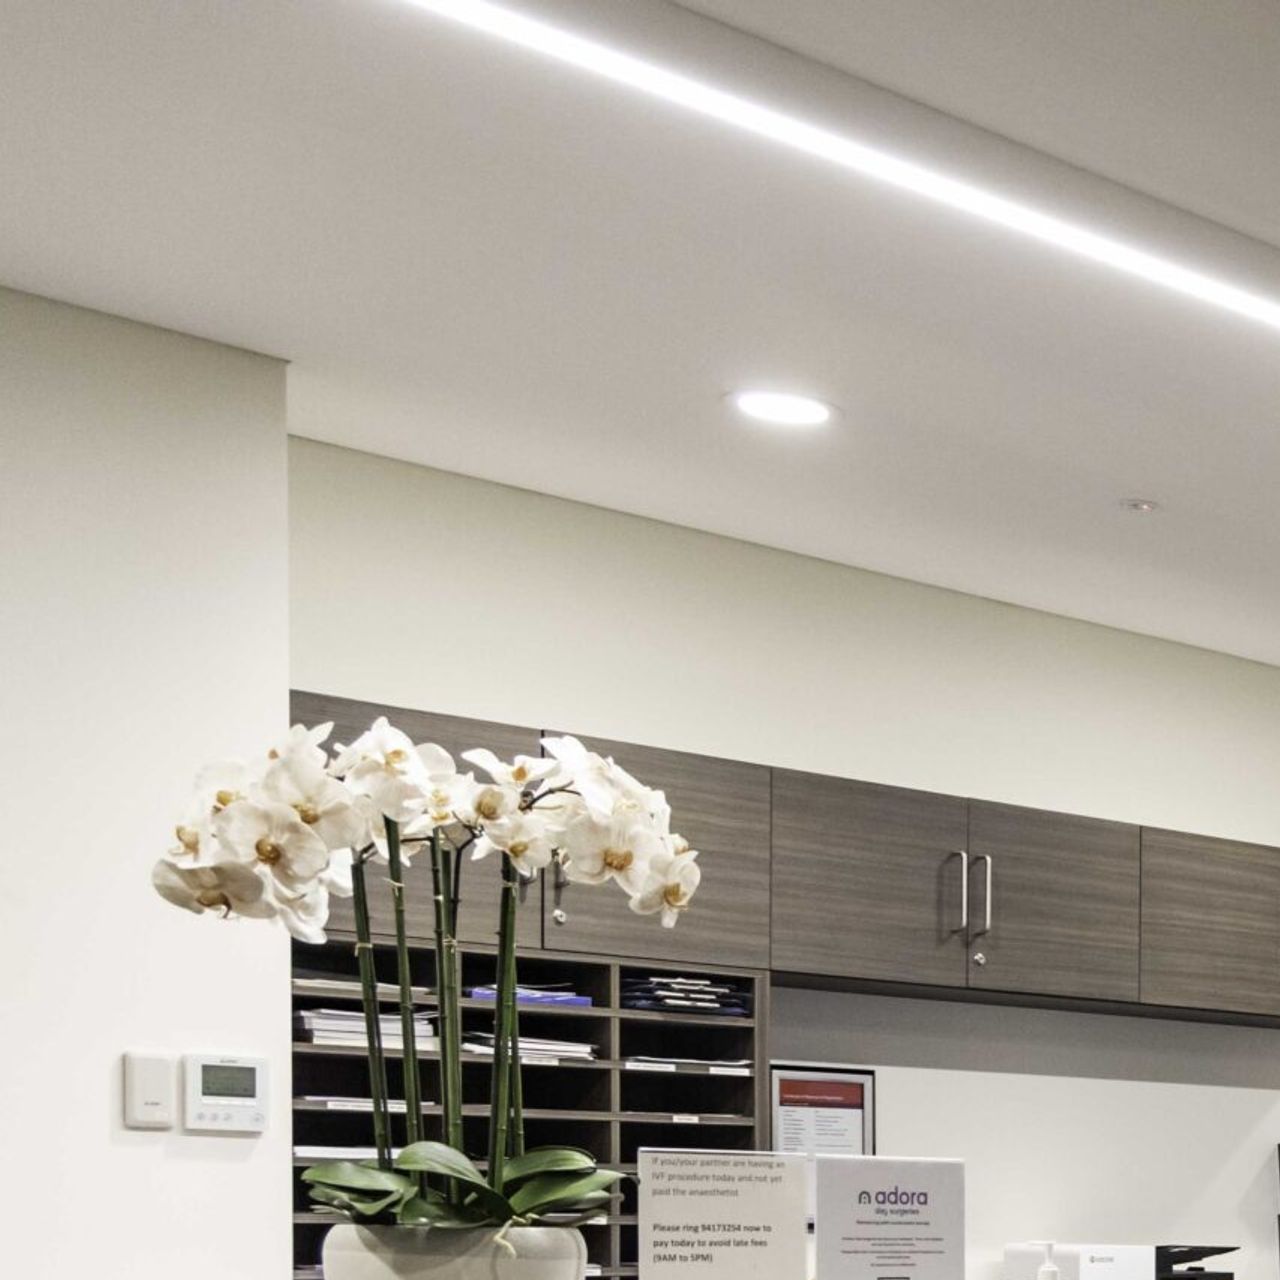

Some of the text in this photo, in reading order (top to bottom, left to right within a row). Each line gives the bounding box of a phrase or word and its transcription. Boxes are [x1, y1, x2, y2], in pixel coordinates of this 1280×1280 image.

[660, 1158, 697, 1167] you/your
[700, 1160, 731, 1168] partner
[747, 1160, 773, 1169] having
[667, 1173, 709, 1182] procedure
[712, 1173, 735, 1182] today
[652, 1188, 670, 1197] paid
[875, 1185, 928, 1205] adora
[653, 1223, 681, 1232] Please
[682, 1223, 699, 1233] ring
[653, 1240, 668, 1248] pay
[671, 1239, 695, 1248] today
[708, 1239, 731, 1247] avoid
[733, 1239, 749, 1247] late
[750, 1239, 768, 1247] fees
